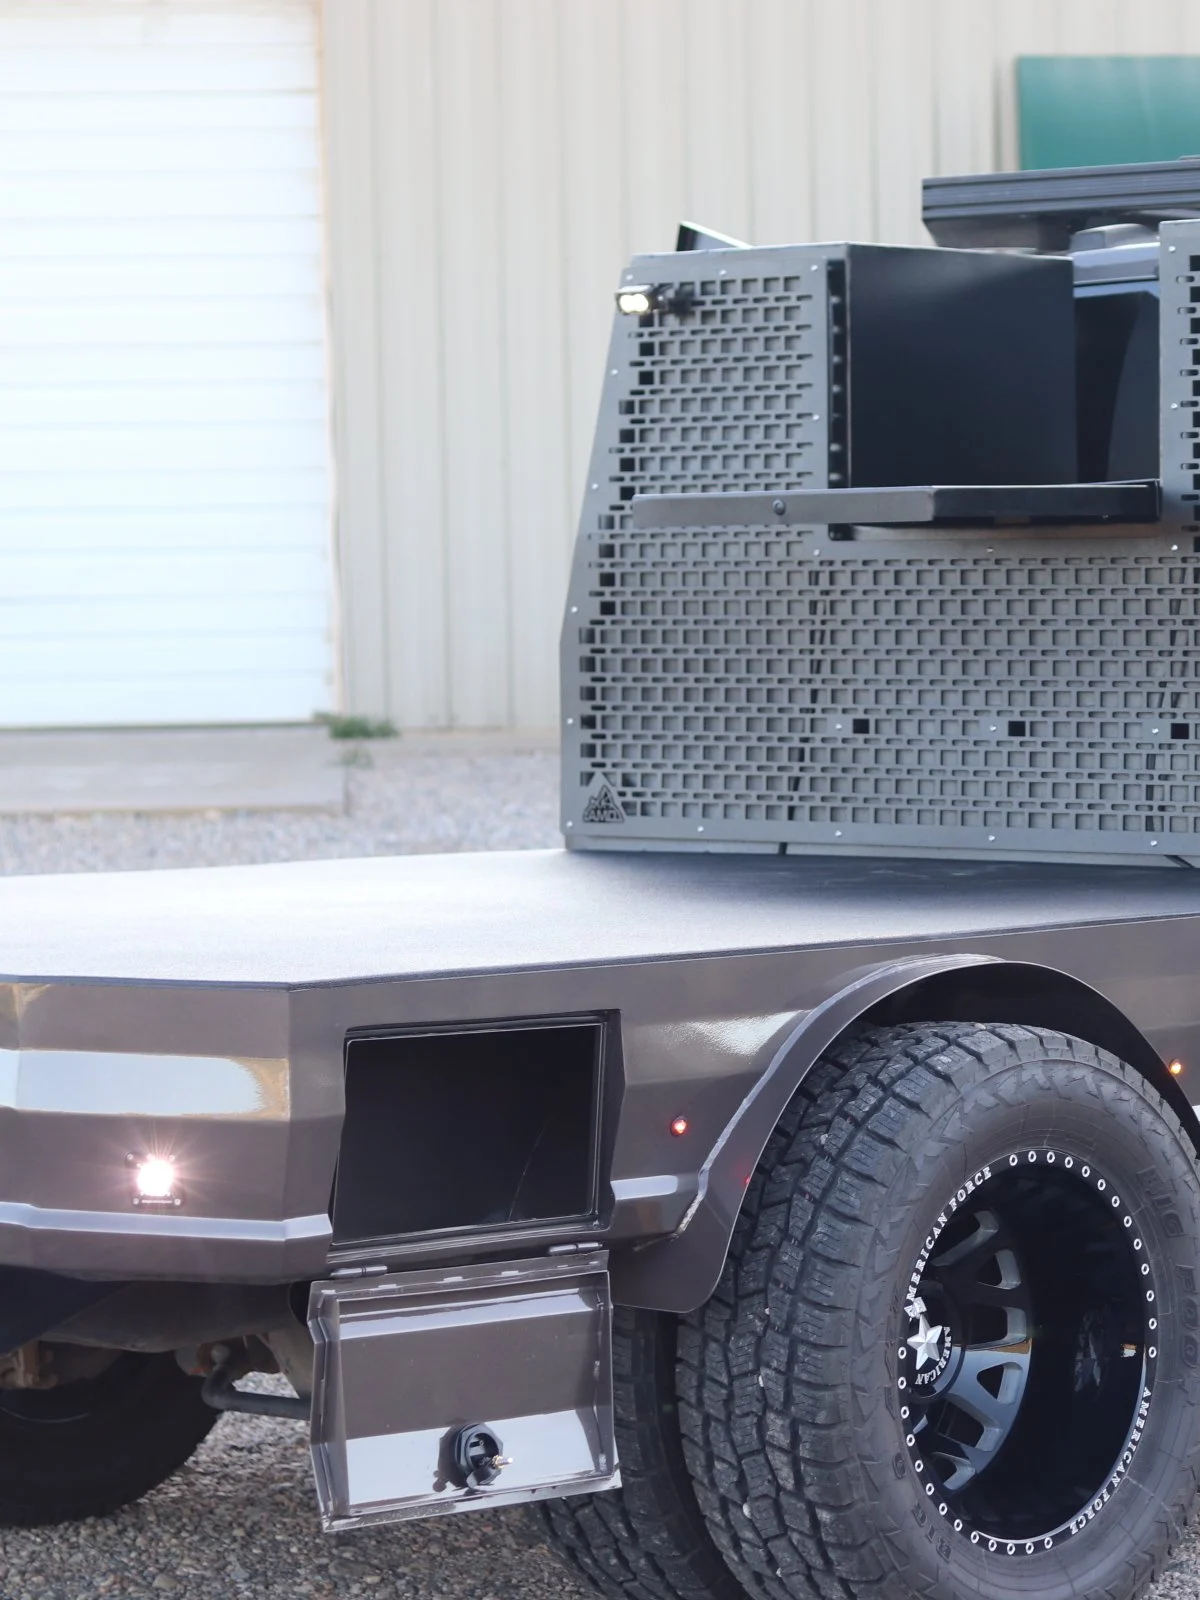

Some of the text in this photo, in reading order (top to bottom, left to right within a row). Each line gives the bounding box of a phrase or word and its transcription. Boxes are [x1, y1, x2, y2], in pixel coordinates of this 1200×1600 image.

[904, 1166, 992, 1322] AMERICAN FORCE
[914, 1326, 952, 1385] AMERICAN
[1069, 1386, 1152, 1535] AMERICAN FORCE
